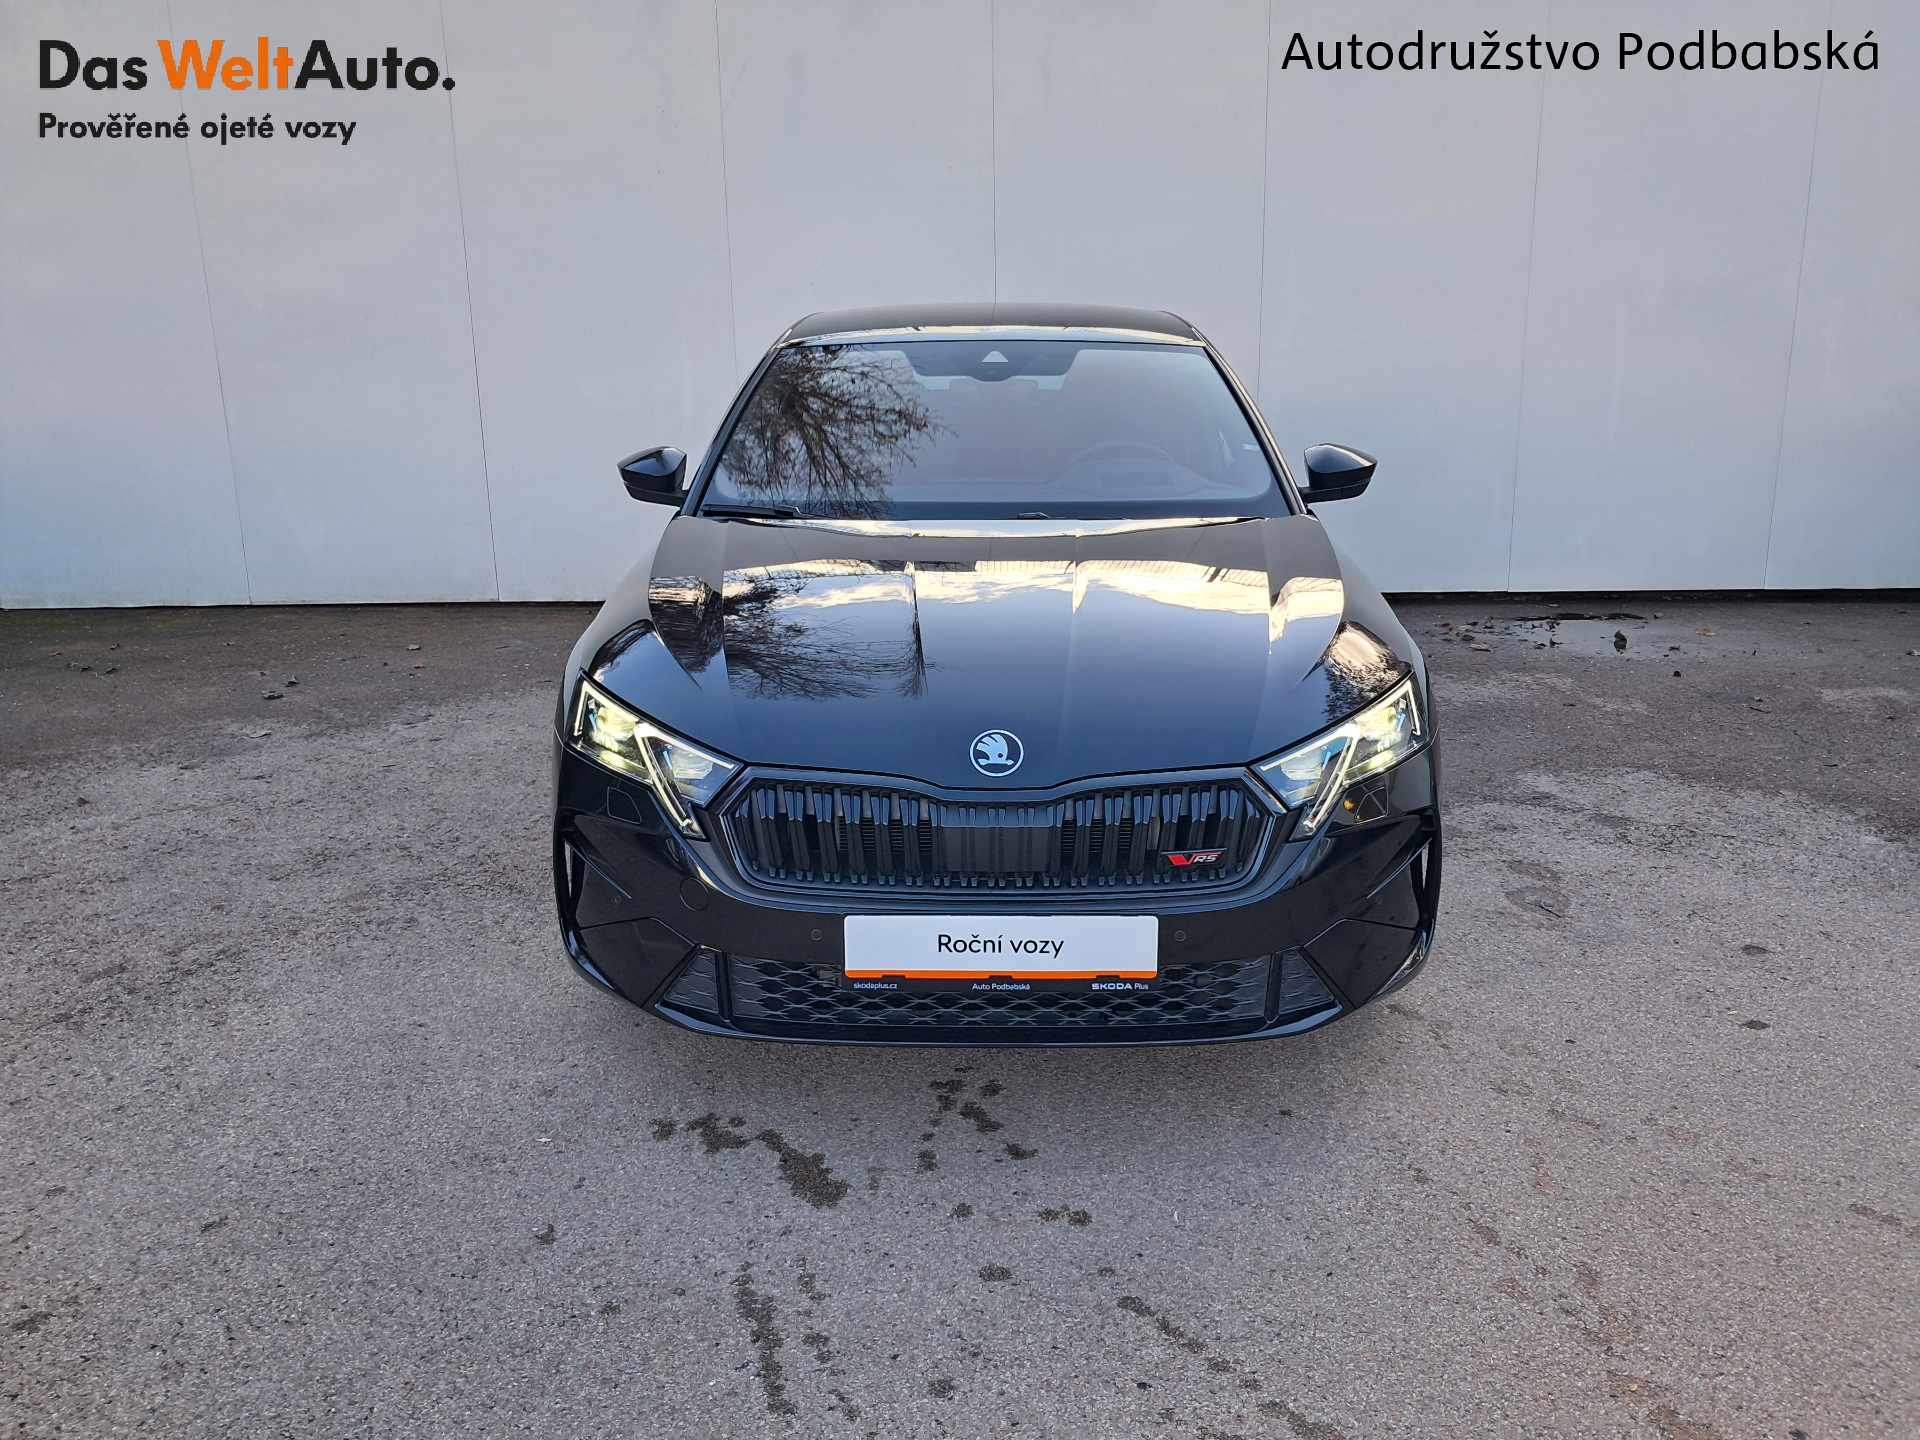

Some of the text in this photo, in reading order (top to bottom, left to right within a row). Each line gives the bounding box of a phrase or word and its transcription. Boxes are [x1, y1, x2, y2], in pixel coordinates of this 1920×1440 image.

[937, 933, 1065, 959] Roční vozy
[853, 981, 898, 990] skodaplus.cz
[1134, 982, 1149, 990] Plus
